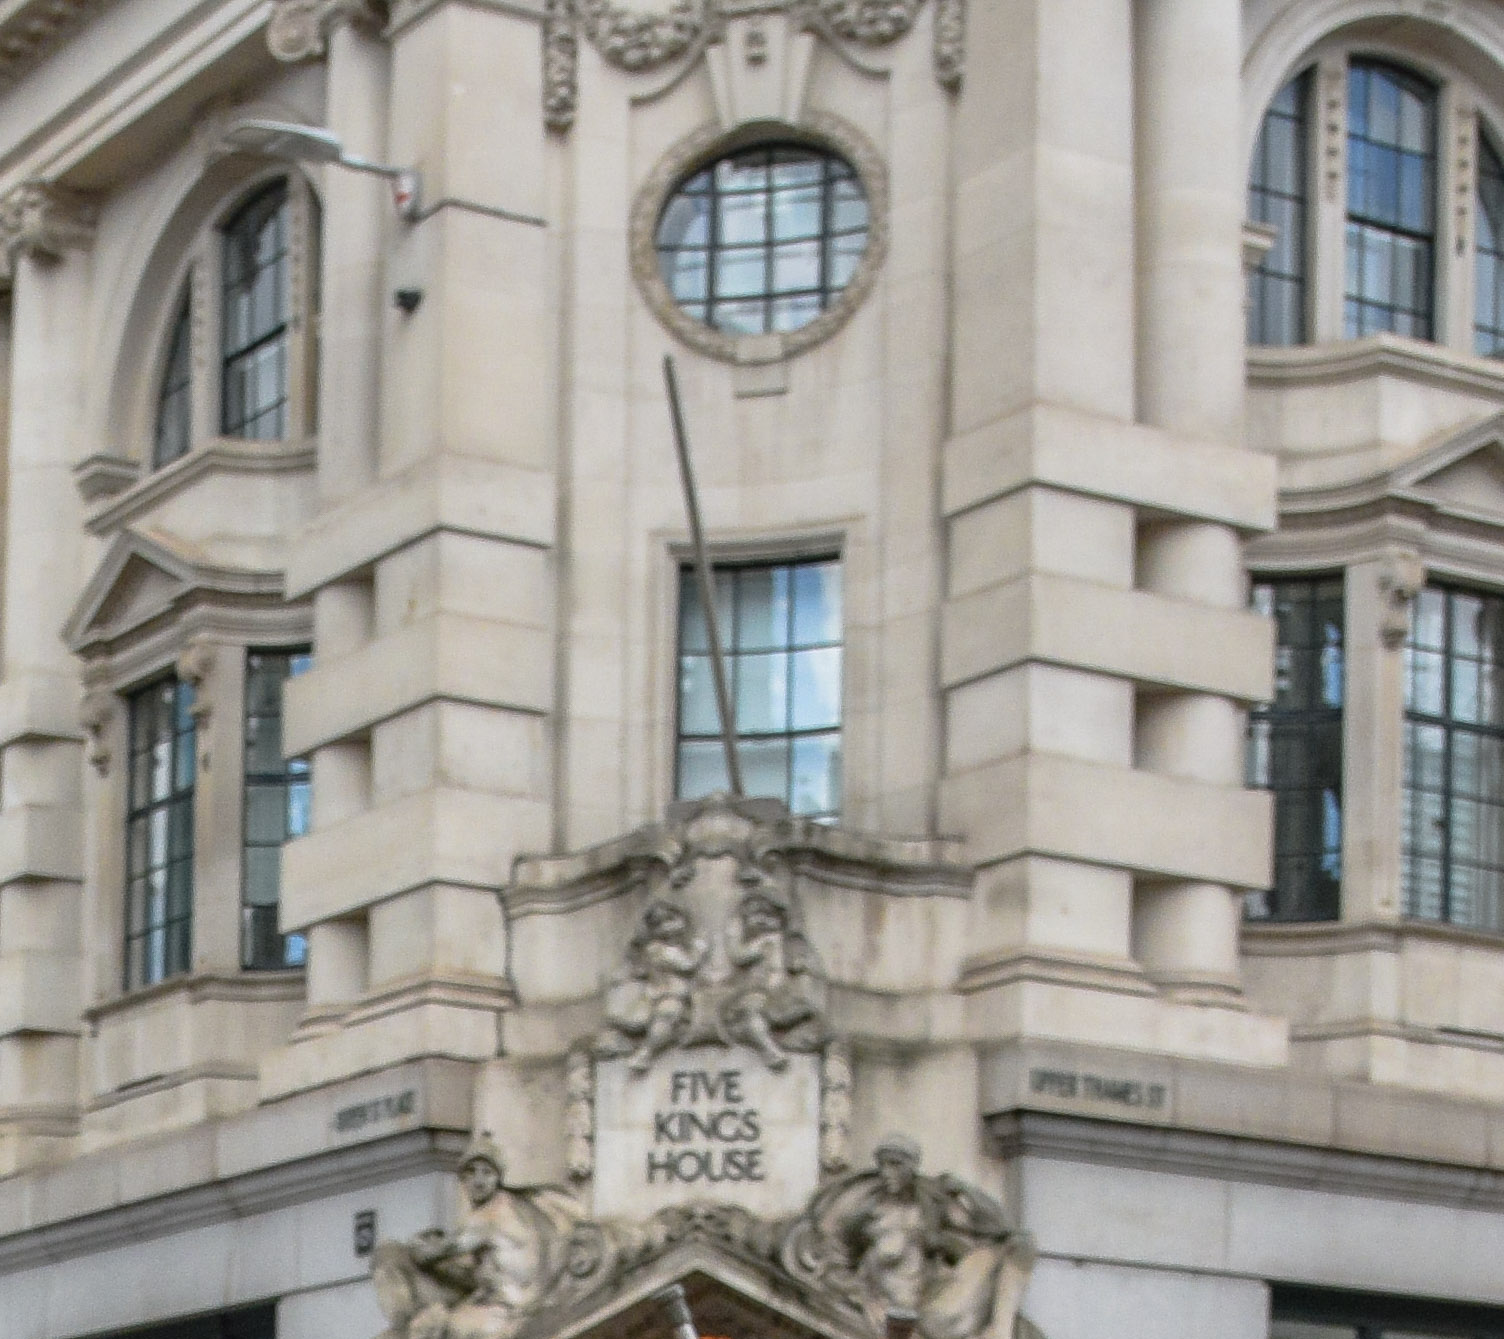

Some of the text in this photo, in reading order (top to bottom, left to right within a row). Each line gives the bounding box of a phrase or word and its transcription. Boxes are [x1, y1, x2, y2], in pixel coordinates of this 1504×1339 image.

[670, 1070, 743, 1103] FIVE
[653, 1109, 761, 1143] KINGS
[646, 1149, 765, 1184] HOUSE
